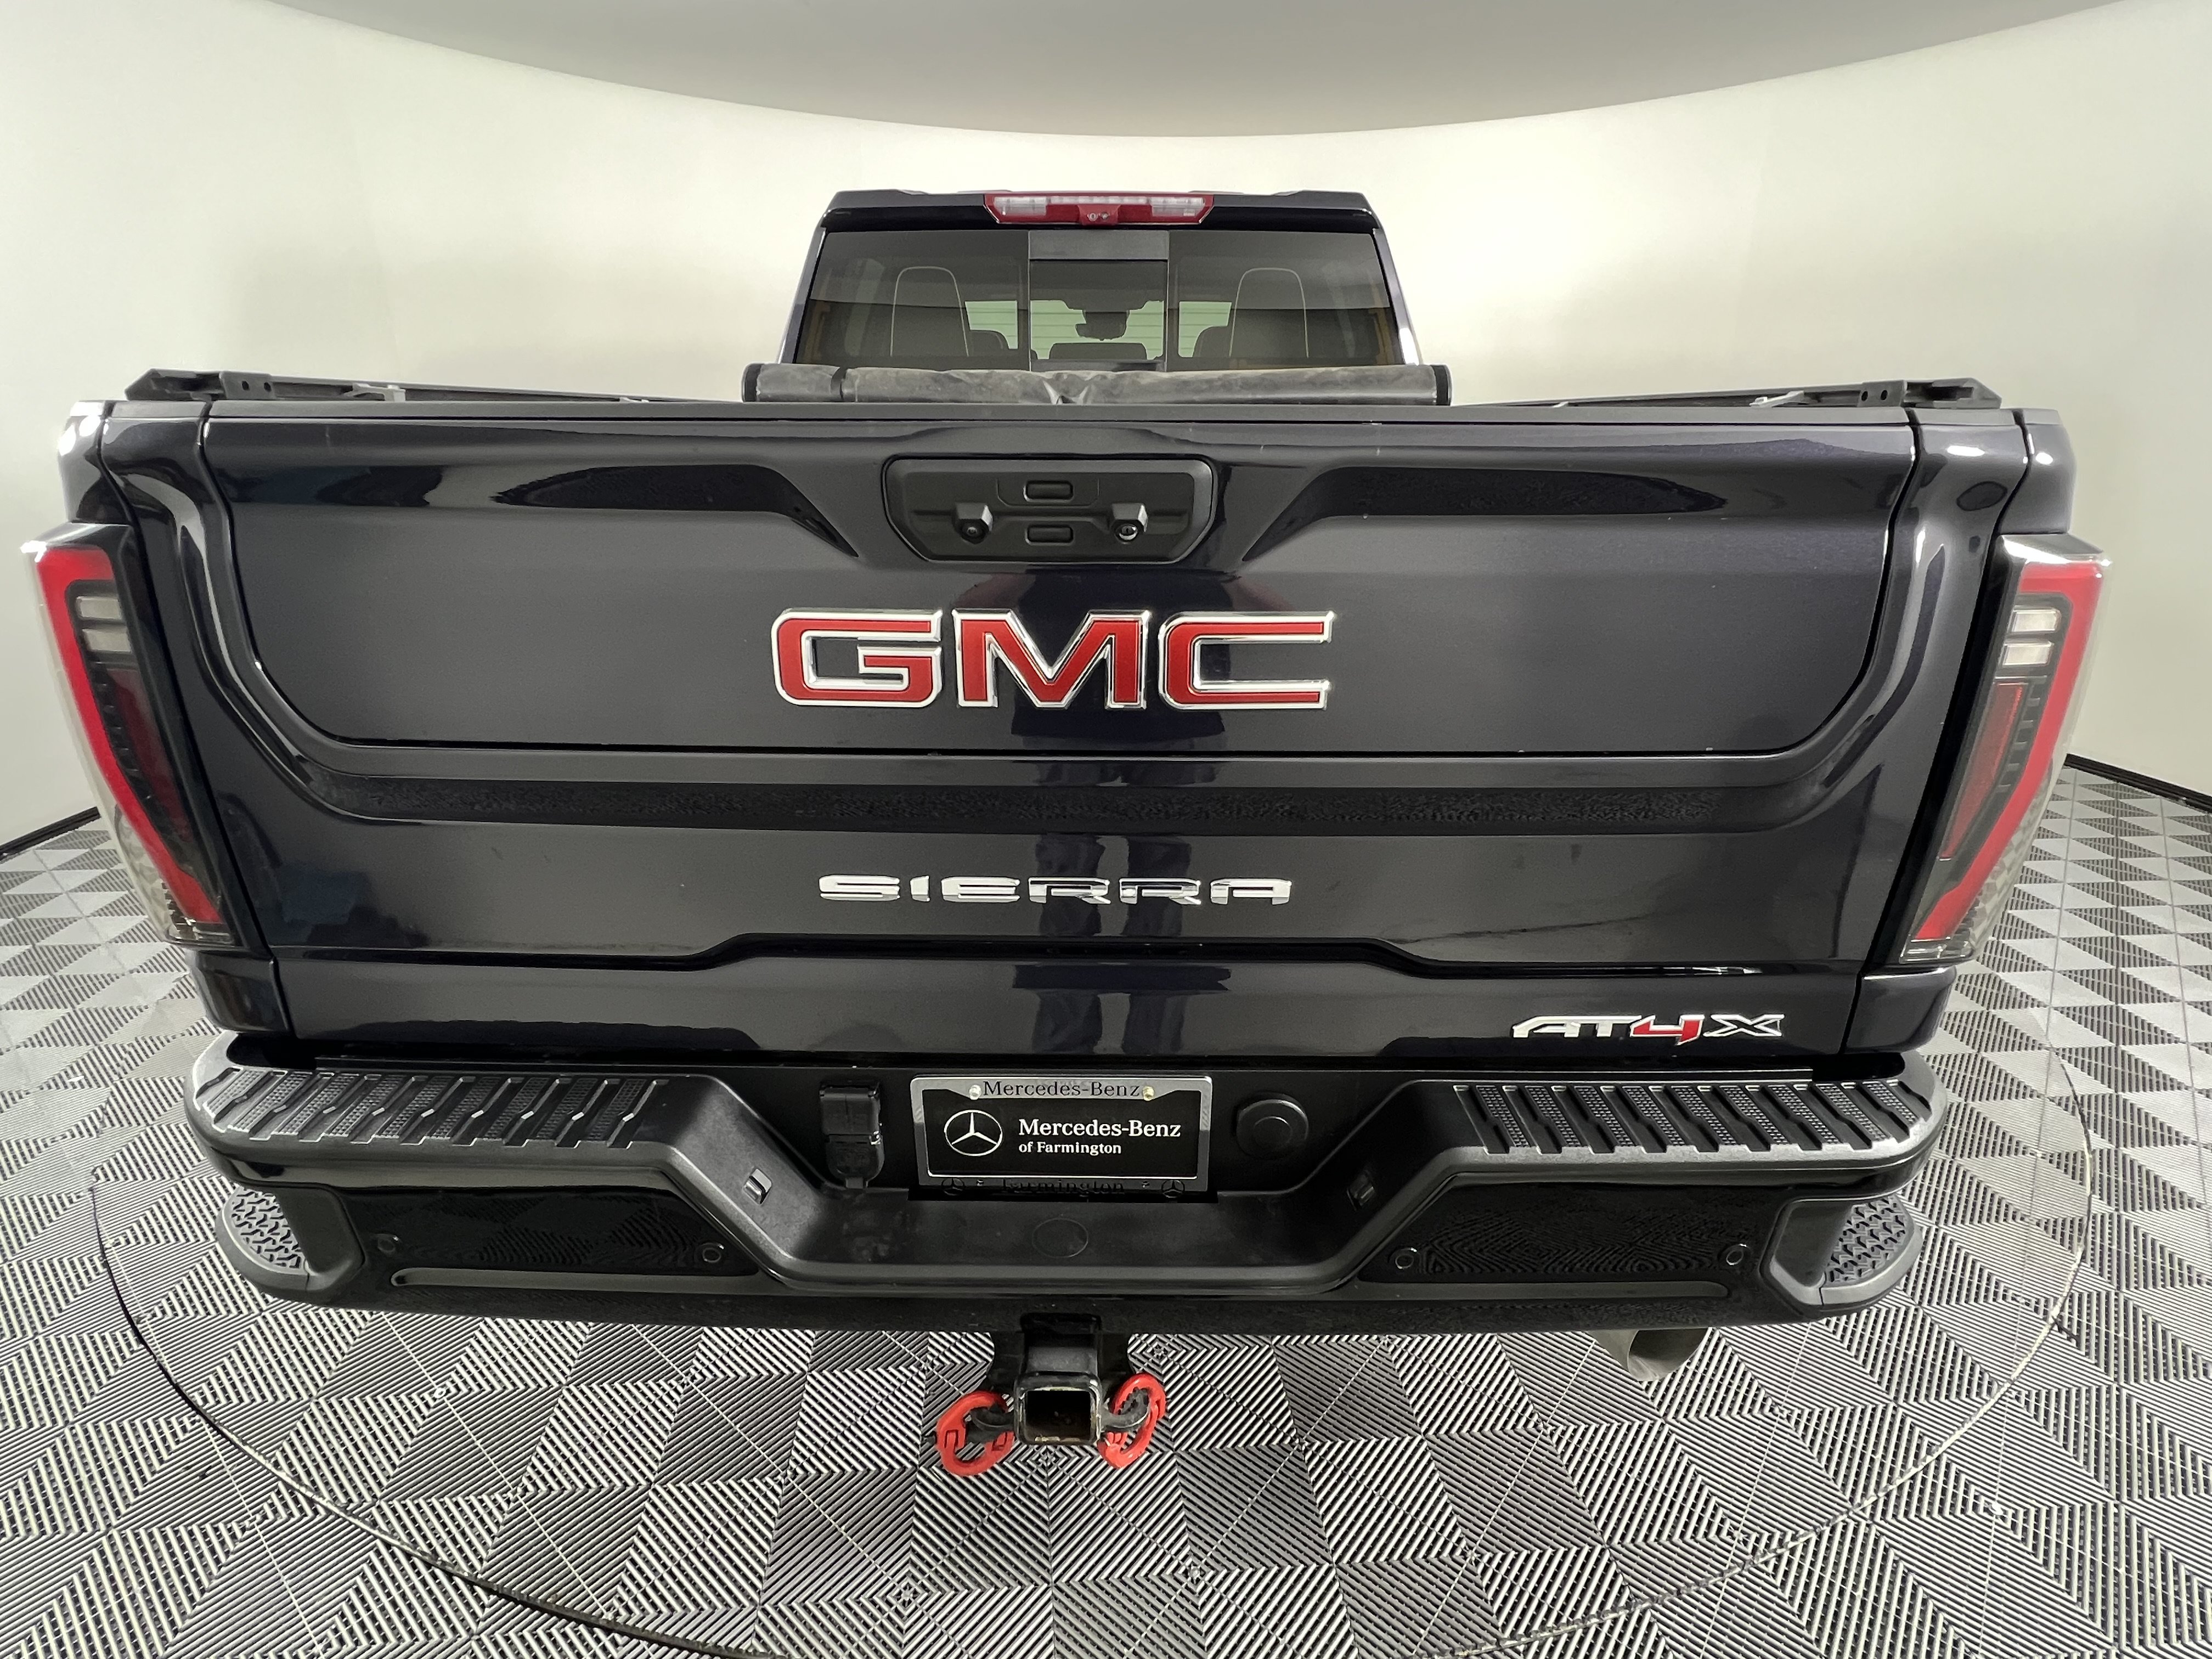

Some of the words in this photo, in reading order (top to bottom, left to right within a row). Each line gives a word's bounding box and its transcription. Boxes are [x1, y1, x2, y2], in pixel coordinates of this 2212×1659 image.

[770, 608, 1335, 709] GMC
[819, 874, 1293, 905] SIERRA
[1513, 1014, 1785, 1045] AT4X
[983, 1081, 1141, 1097] Mercedes-Benz
[1018, 1119, 1181, 1137] Mercedes-Benz
[1018, 1142, 1032, 1153] of
[1036, 1142, 1121, 1155] Farmington
